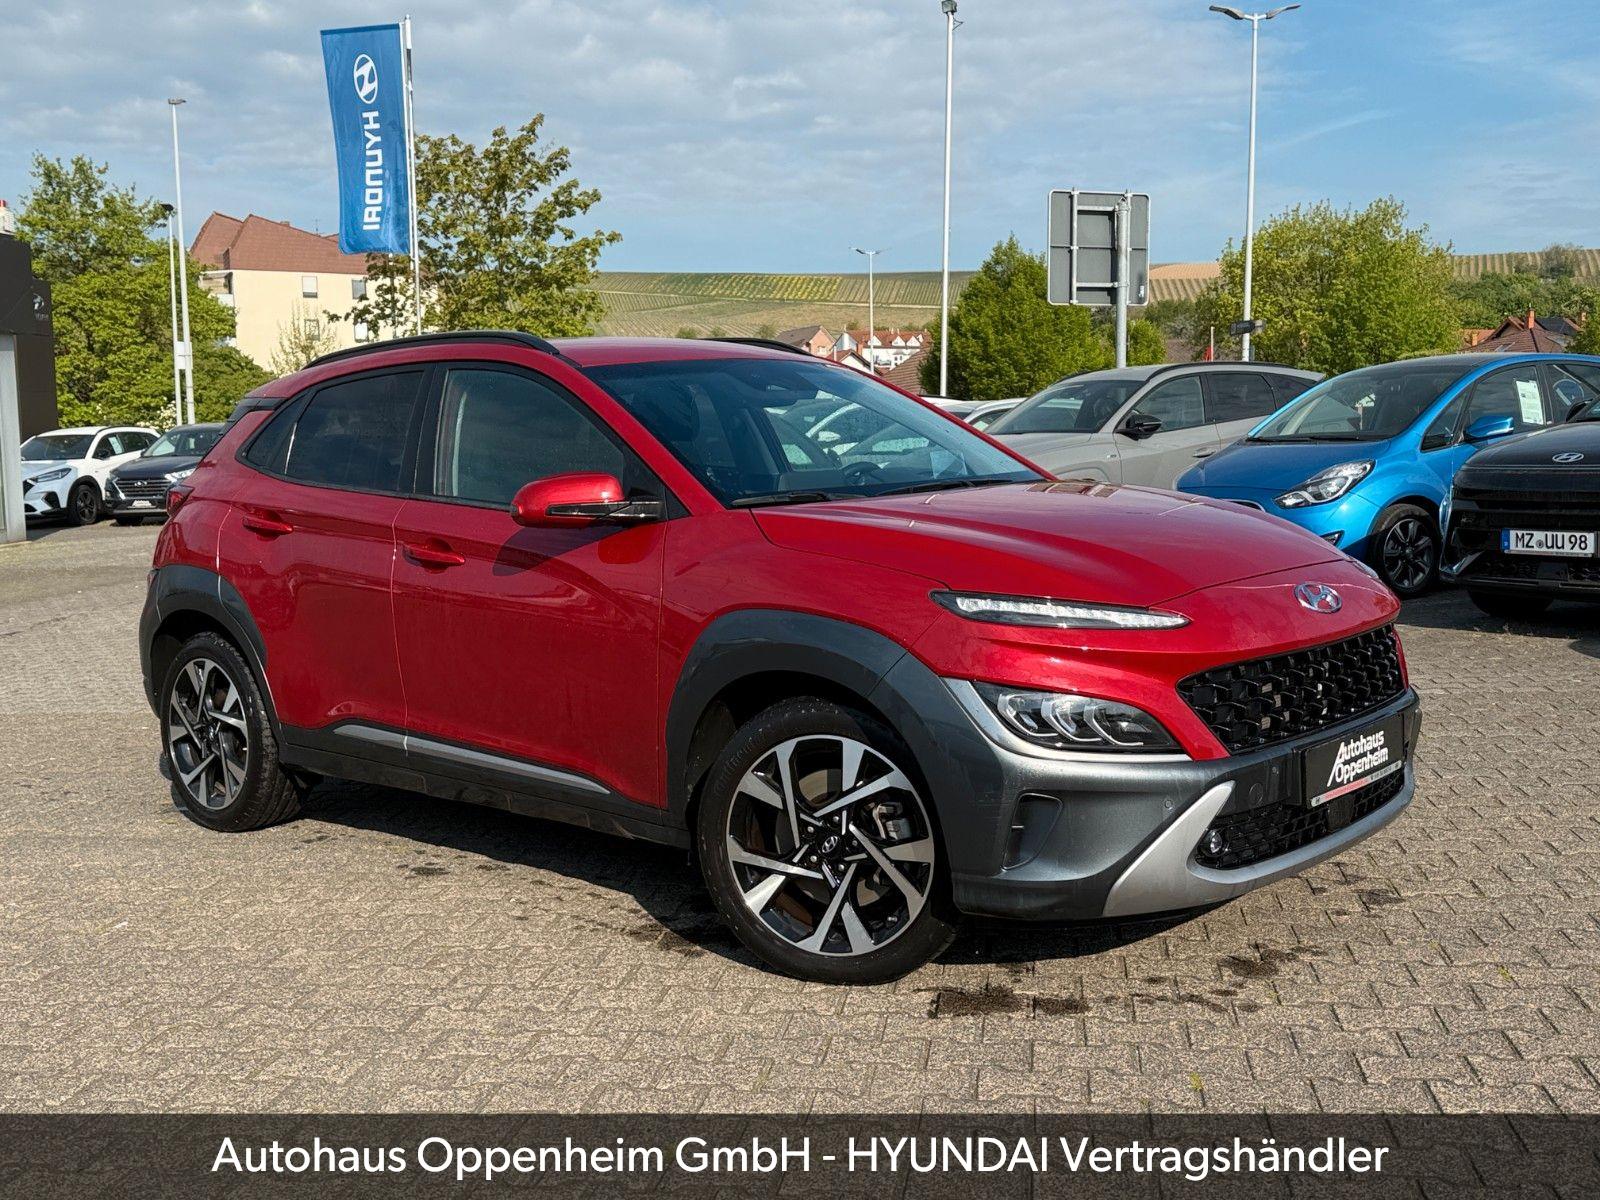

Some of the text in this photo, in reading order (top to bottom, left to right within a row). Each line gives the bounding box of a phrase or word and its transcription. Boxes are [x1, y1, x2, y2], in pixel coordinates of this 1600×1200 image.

[1515, 532, 1588, 551] MZ UU 98
[1326, 730, 1385, 787] Autohaus
[1335, 746, 1389, 784] Oppenheim
